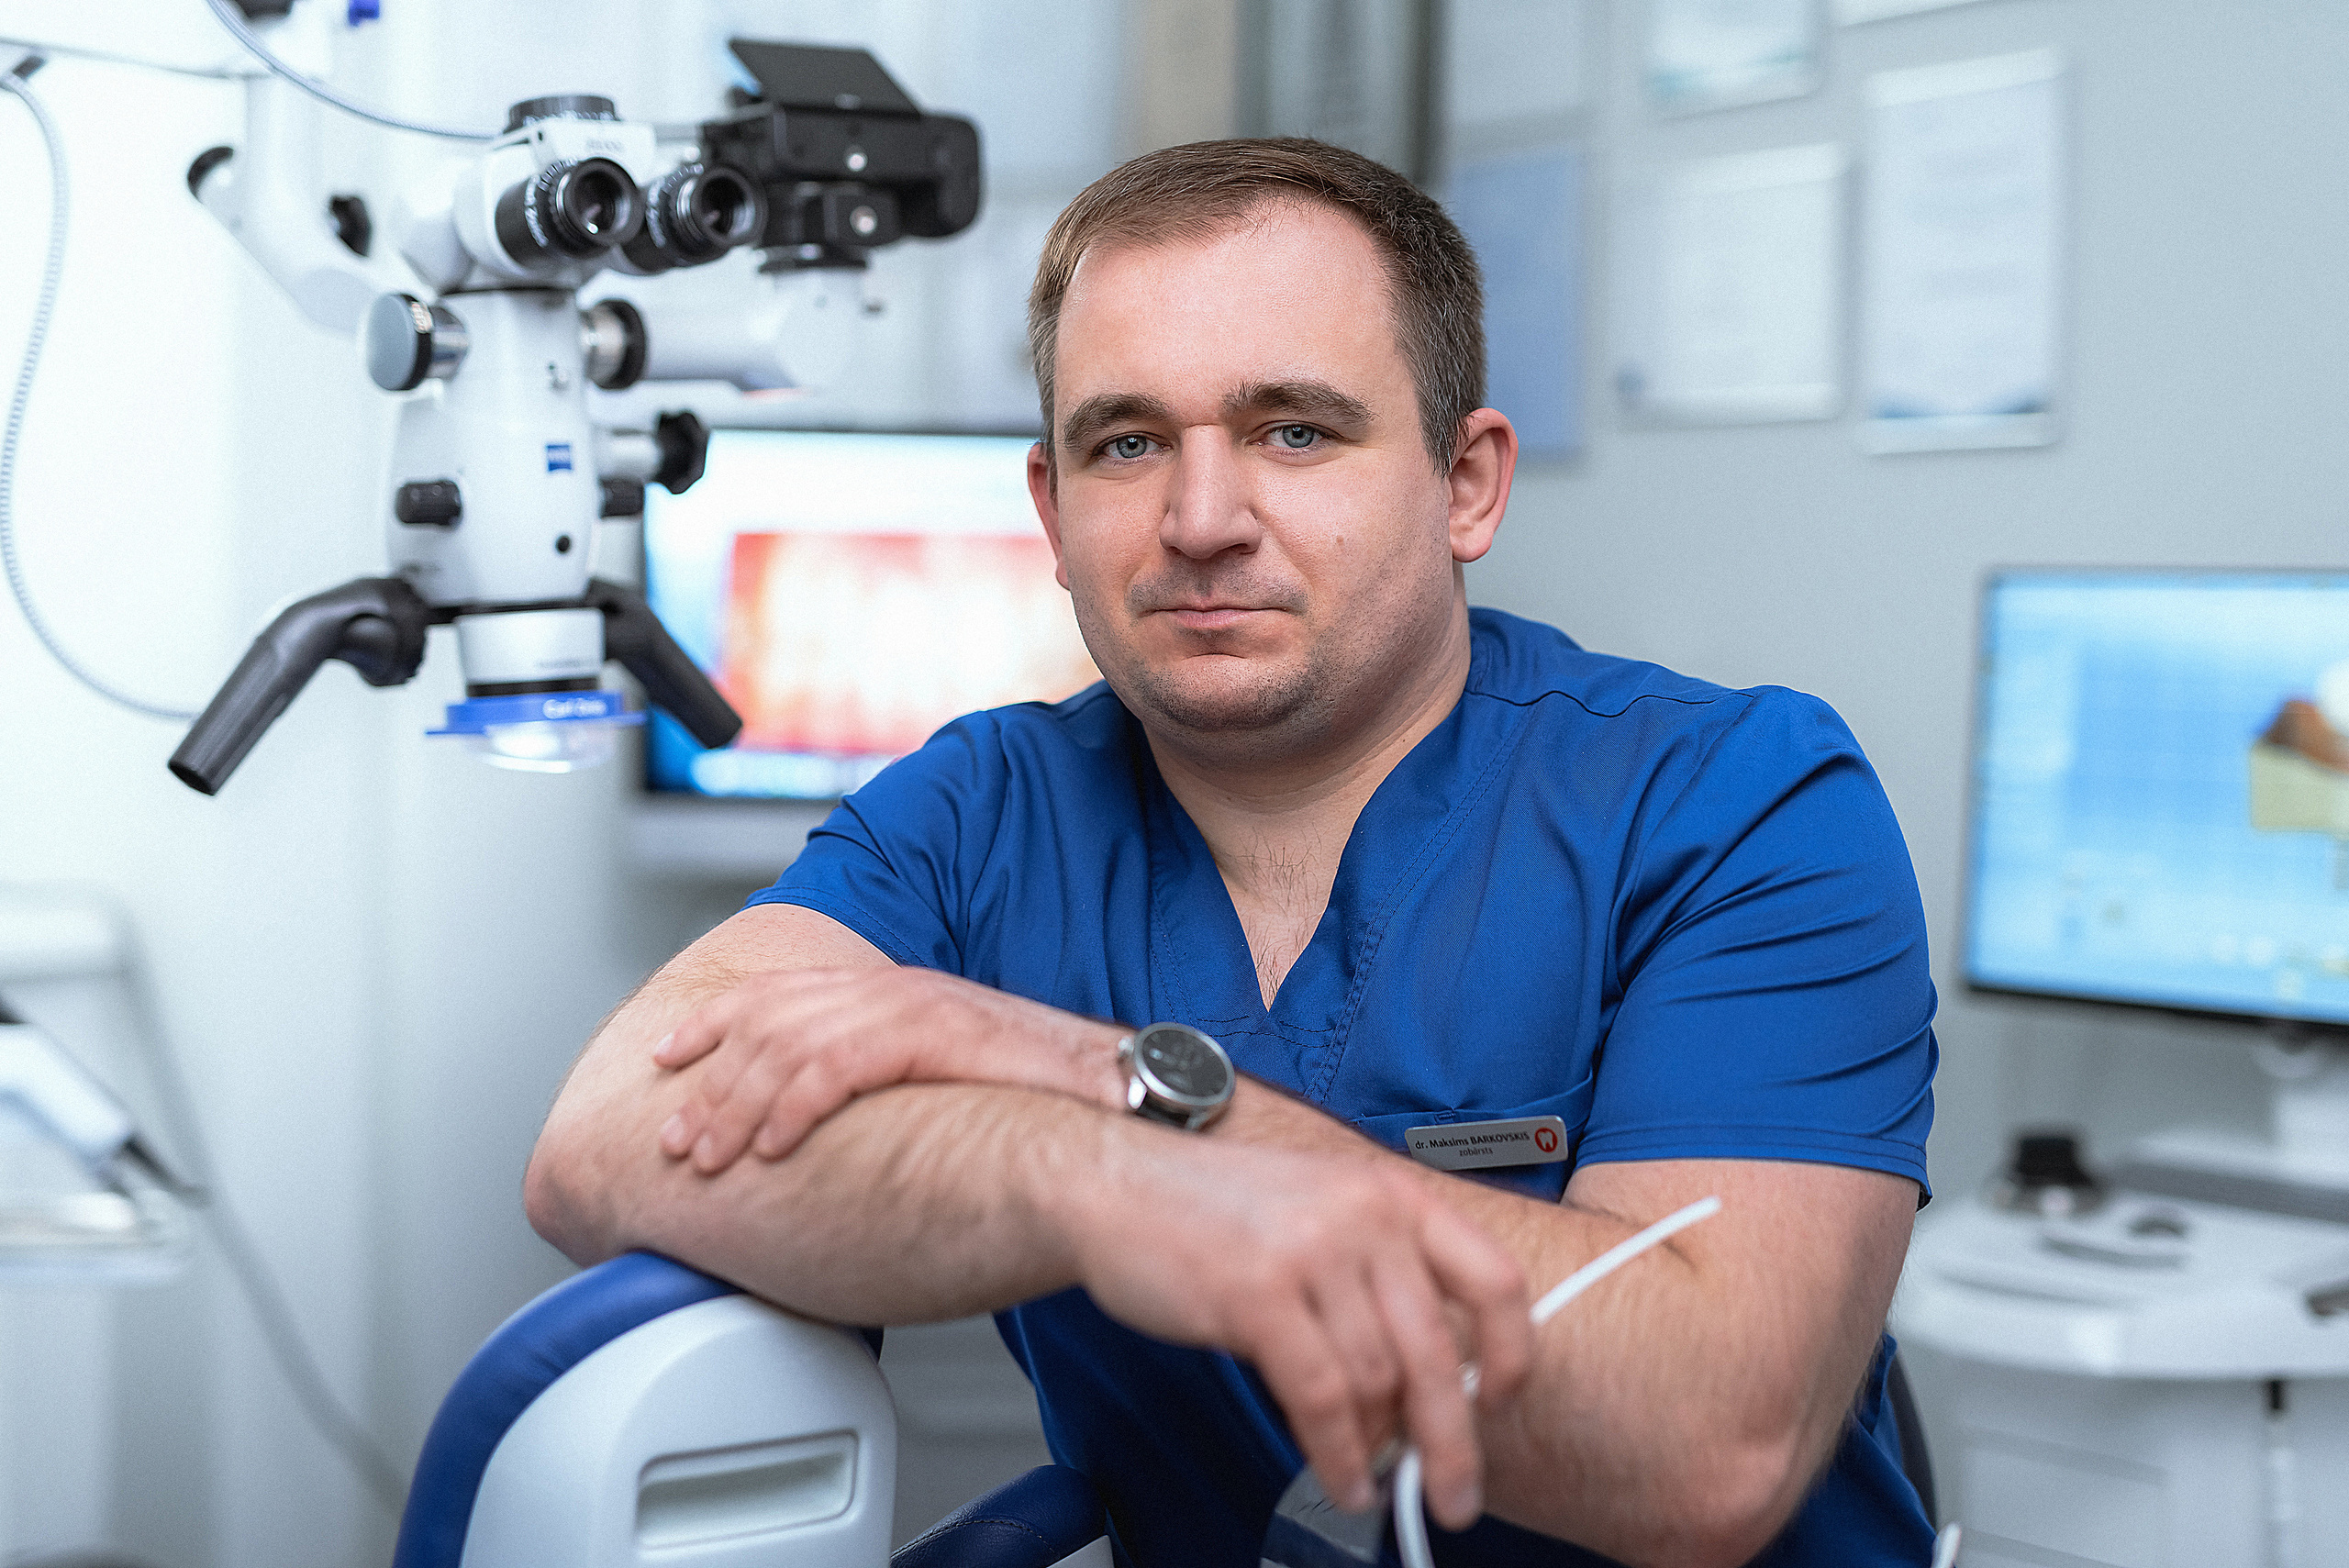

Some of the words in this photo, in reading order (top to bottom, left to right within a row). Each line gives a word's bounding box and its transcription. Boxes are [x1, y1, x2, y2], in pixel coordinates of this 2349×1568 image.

[1415, 1140, 1428, 1149] dr.
[1429, 1138, 1469, 1148] Maksims
[1469, 1131, 1531, 1145] BARKOVSKIS
